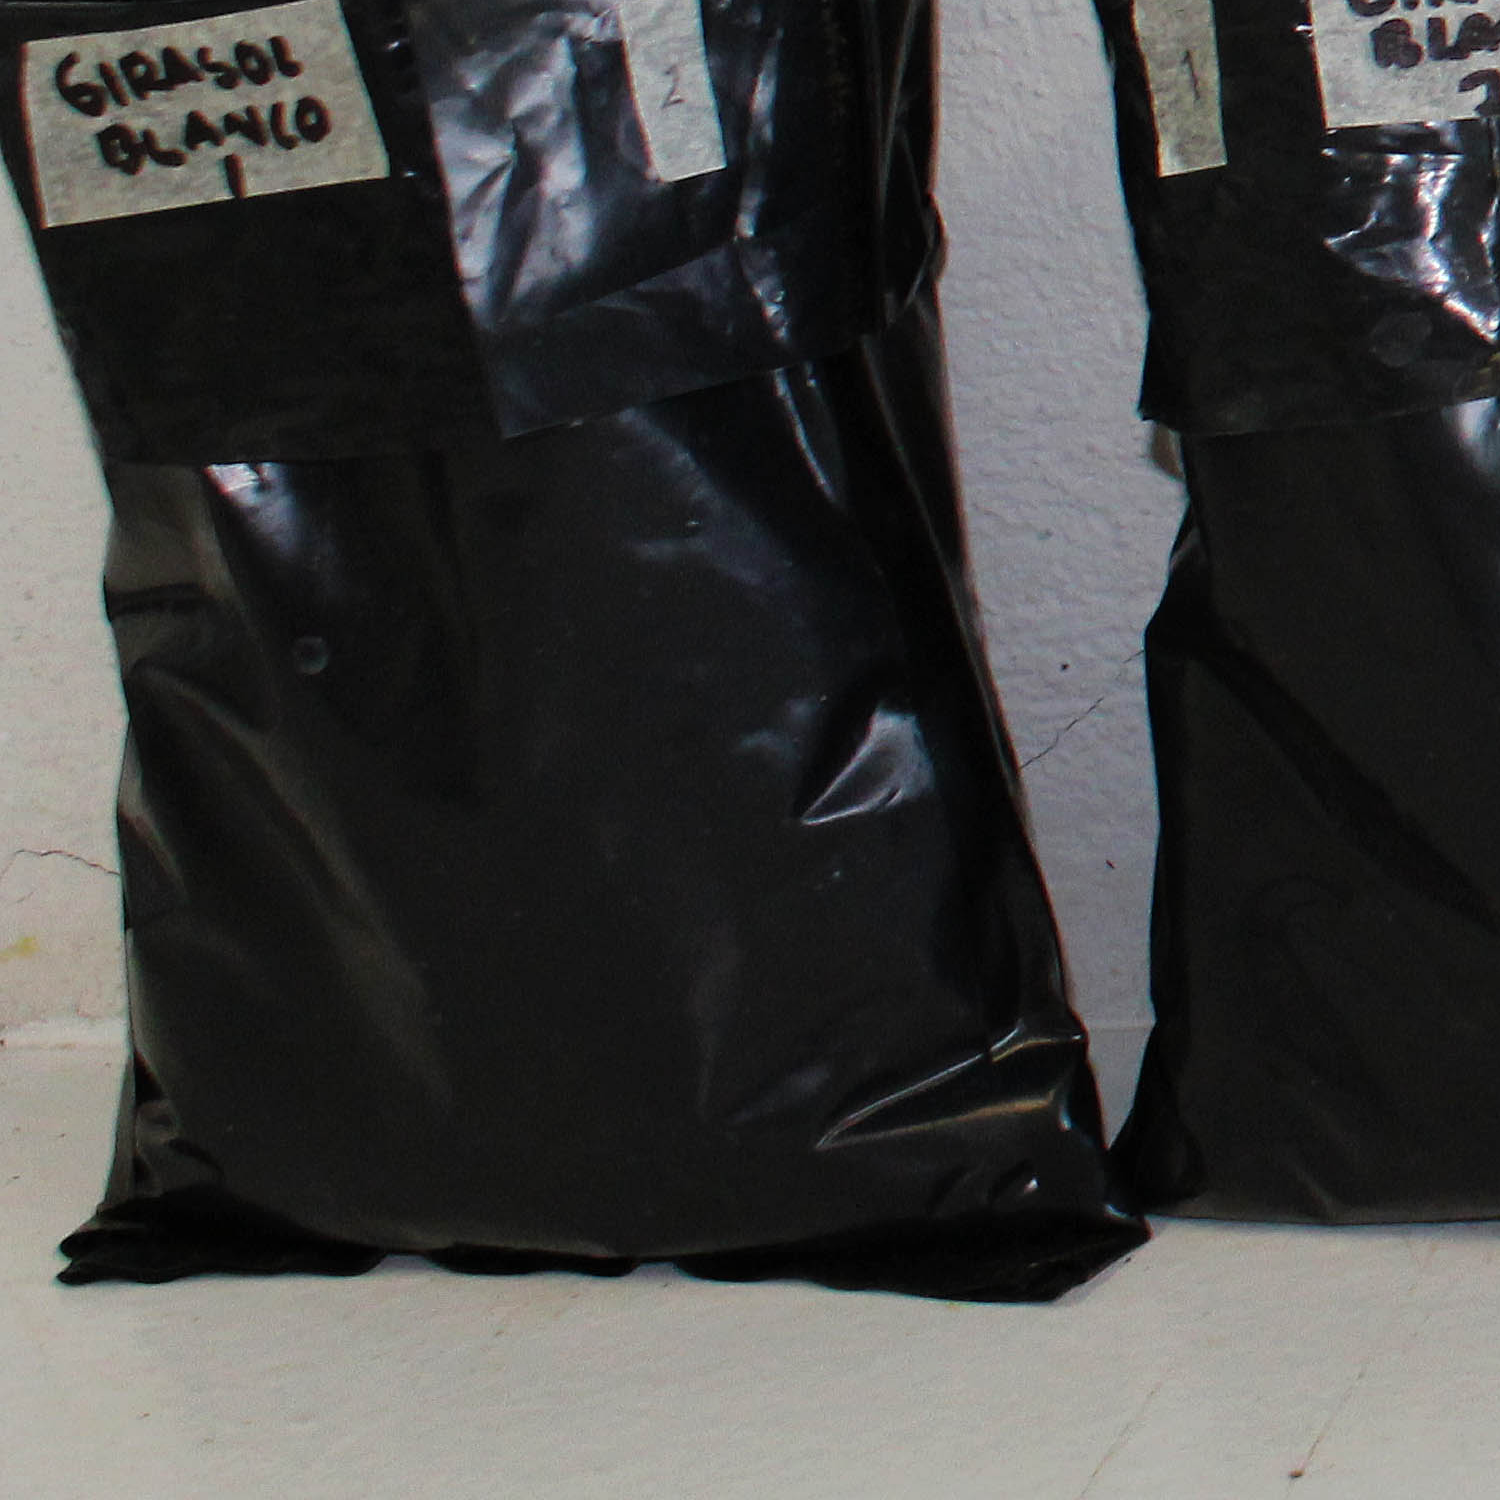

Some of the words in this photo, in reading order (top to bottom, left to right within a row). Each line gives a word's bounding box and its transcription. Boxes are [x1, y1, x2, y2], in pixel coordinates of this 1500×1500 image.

[56, 35, 303, 117] GIRASOL
[661, 63, 685, 109] 2
[98, 95, 332, 175] BLANCO
[225, 152, 247, 198] 1
